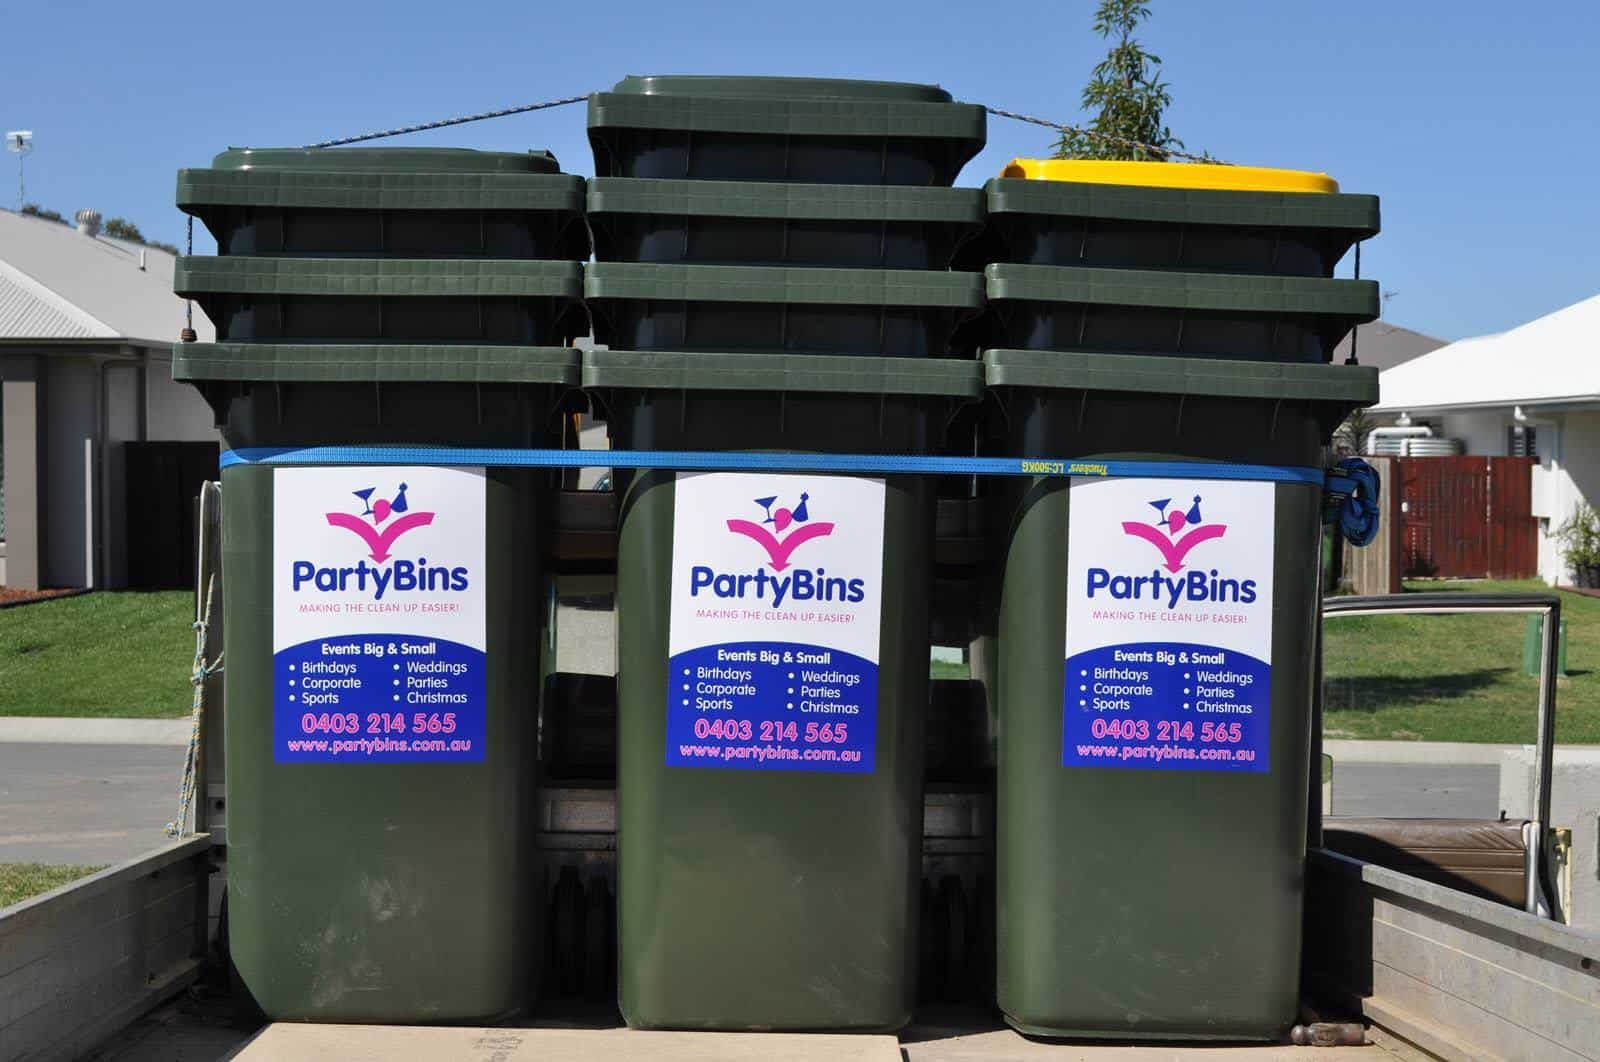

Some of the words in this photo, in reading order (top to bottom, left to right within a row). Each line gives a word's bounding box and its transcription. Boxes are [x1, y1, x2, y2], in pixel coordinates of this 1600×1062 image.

[293, 558, 468, 600] PartyBins
[691, 567, 864, 608] PartyBins
[1088, 568, 1256, 609] PartyBins
[299, 604, 341, 613] MAKING
[345, 604, 363, 613] THE
[367, 604, 400, 613] CLEAN
[403, 604, 418, 612] UP
[421, 604, 459, 613] EASIER!
[696, 610, 739, 620] MAKING
[743, 611, 761, 620] THE
[764, 612, 797, 621] CLEAN
[800, 613, 815, 622] UP
[818, 614, 855, 623] EASIER!
[1092, 611, 1135, 620] MAKING
[1139, 612, 1156, 621] THE
[1160, 613, 1192, 622] CLEAN
[1195, 614, 1209, 623] UP
[1212, 614, 1247, 624] EASIER!
[322, 643, 360, 655] Events
[364, 643, 384, 657] Big
[387, 643, 397, 654] &
[401, 642, 436, 654] Small
[718, 649, 757, 661] Events
[760, 651, 779, 665] Big
[783, 652, 793, 663] &
[796, 652, 830, 664] Small
[1115, 650, 1153, 662] Events
[1157, 651, 1175, 665] Big
[1179, 652, 1188, 663] &
[1192, 653, 1224, 664] Small
[303, 661, 356, 675] Birthdays
[407, 661, 467, 675] Weddings
[697, 667, 751, 682] Birthdays
[1095, 668, 1148, 682] Birthdays
[302, 677, 361, 691] Corporate
[408, 677, 447, 688] Parties
[802, 671, 860, 686] Weddings
[1197, 671, 1253, 686] Weddings
[697, 682, 756, 696] Corporate
[801, 686, 840, 698] Parties
[1094, 683, 1152, 699] Corporate
[1197, 686, 1234, 698] Parties
[302, 692, 339, 706] Sports
[407, 692, 467, 703] Christmas
[696, 697, 732, 711] Sports
[801, 701, 859, 714] Christmas
[1093, 698, 1130, 712] Sports
[1196, 701, 1252, 713] Christmas
[302, 713, 359, 734] 0403
[367, 713, 406, 733] 214
[412, 713, 456, 733] 565
[695, 718, 752, 740] 0403
[760, 721, 798, 742] 214
[805, 722, 847, 743] 565
[1091, 719, 1150, 740] 0403
[1157, 720, 1194, 741] 214
[1201, 722, 1241, 743] 565
[288, 738, 471, 755] www.partybins.com.au
[680, 743, 860, 762] www.partybins.com.au
[1077, 744, 1255, 761] www.partybins.com.au
